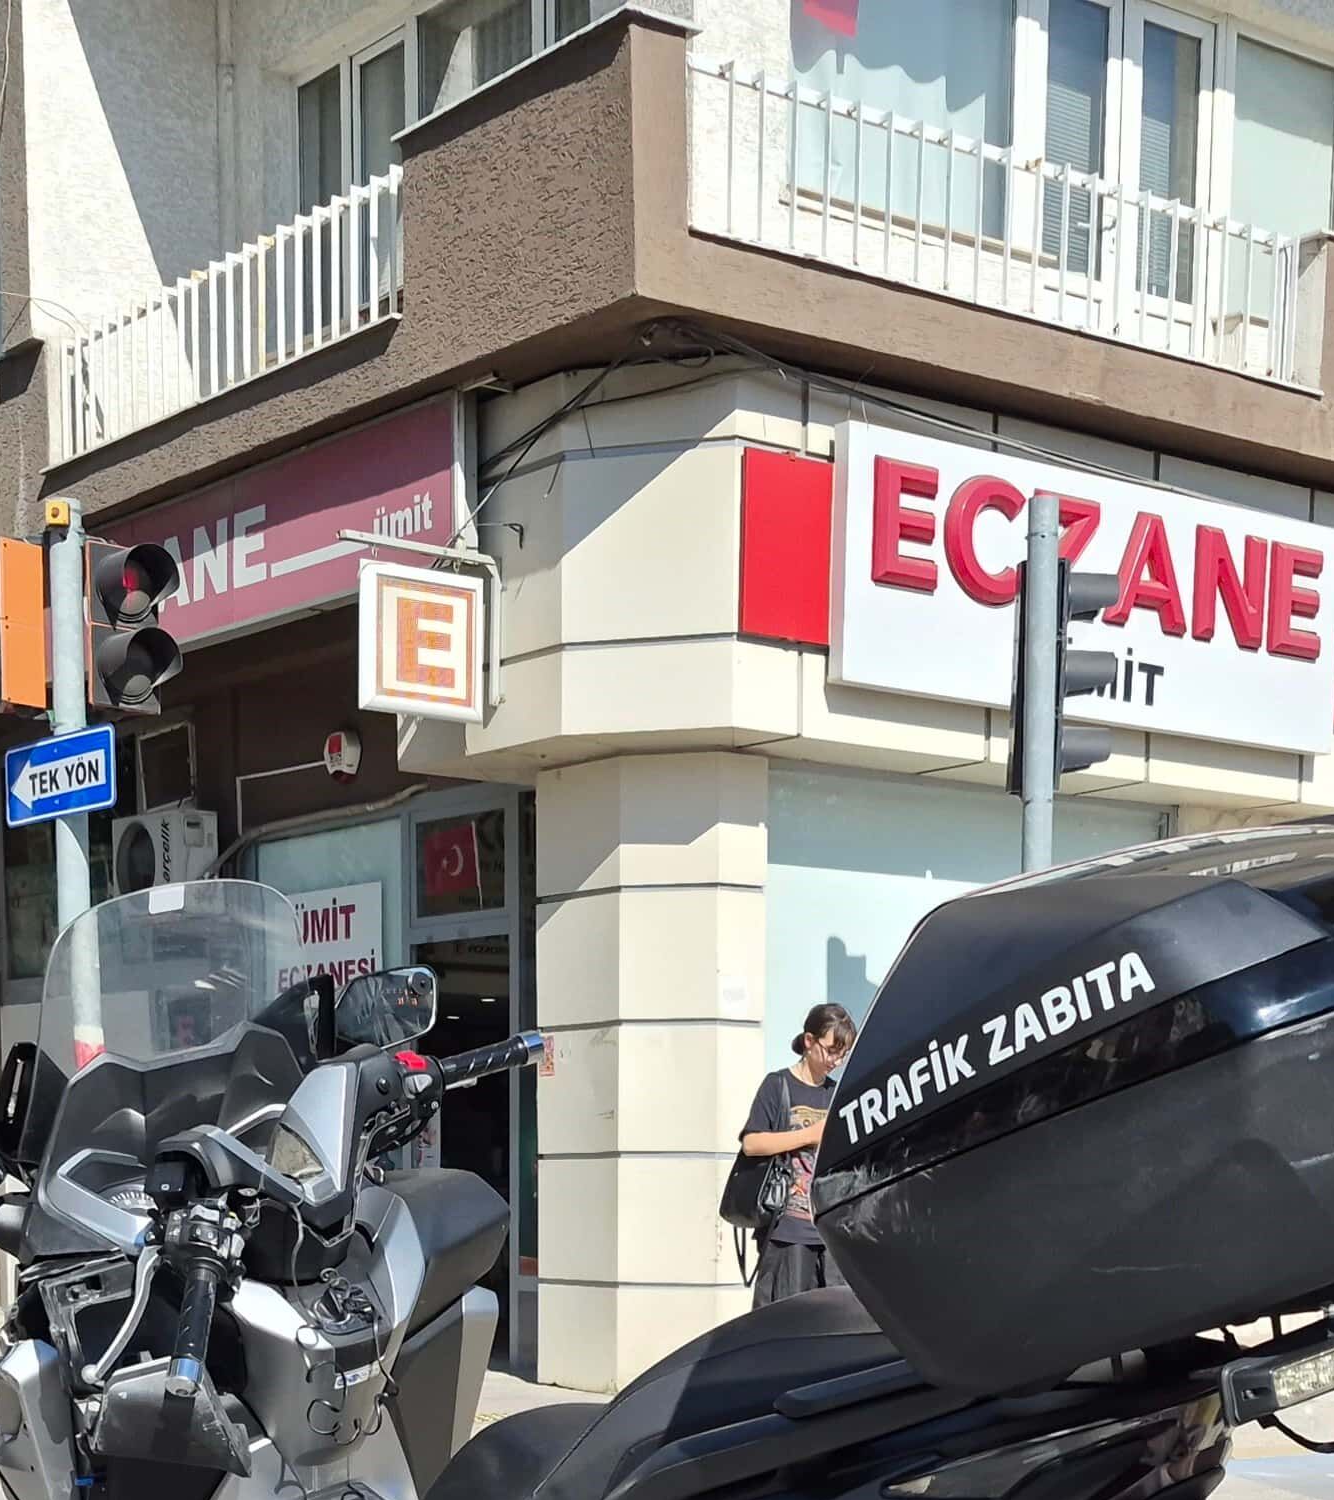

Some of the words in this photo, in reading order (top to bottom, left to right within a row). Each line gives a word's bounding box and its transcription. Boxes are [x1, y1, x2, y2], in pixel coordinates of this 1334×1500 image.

[373, 491, 433, 538] ümit
[397, 597, 455, 688] E
[28, 768, 60, 797] TEK
[65, 757, 100, 788] YÖN
[839, 1033, 977, 1144] TRAFİK
[982, 952, 1155, 1066] ZABITA
